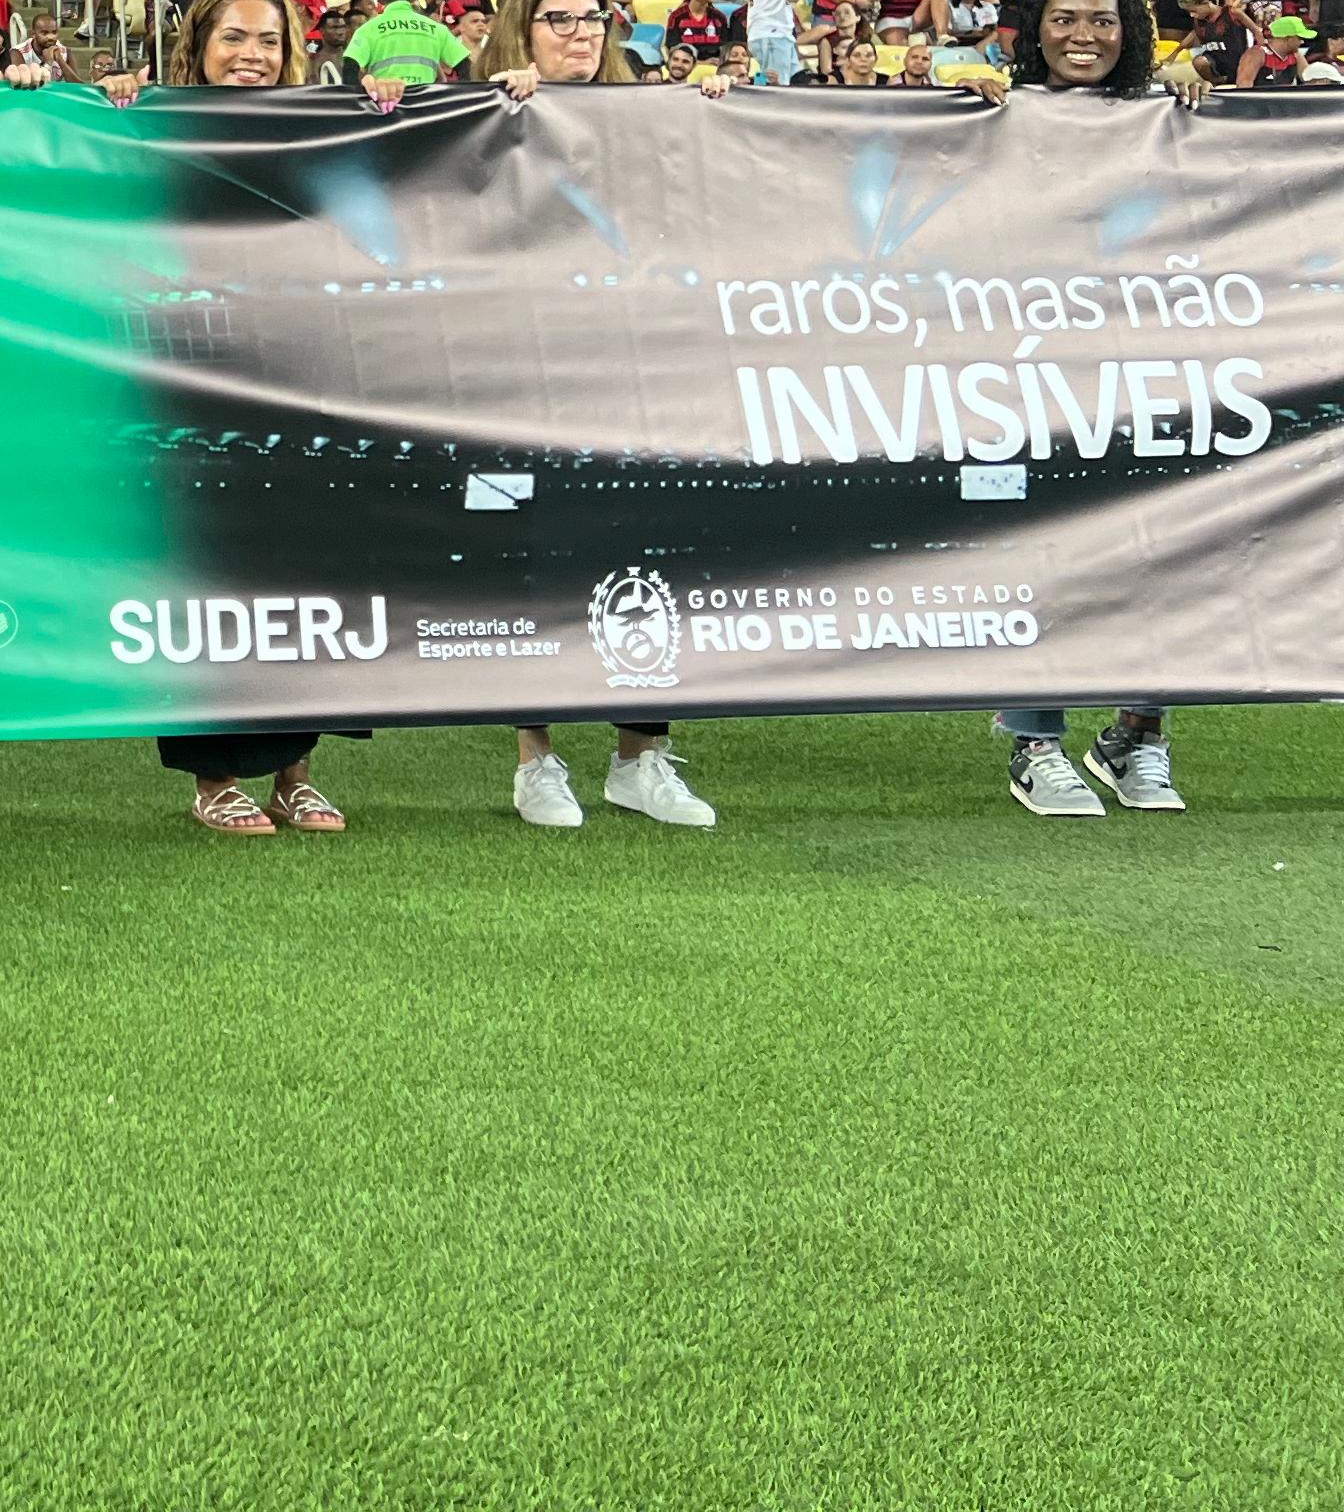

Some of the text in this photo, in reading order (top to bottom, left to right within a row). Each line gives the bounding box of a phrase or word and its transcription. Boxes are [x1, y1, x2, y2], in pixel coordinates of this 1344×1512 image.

[377, 18, 437, 35] SUNSET
[716, 254, 1266, 348] raros, mas não
[736, 335, 1274, 465] INVISÍVEIS
[687, 584, 1035, 610] GOVERNO DO ESTADO
[110, 594, 390, 665] SUDERJ
[416, 617, 536, 637] Secretaria de
[689, 609, 1039, 653] RIO DE JANEIRO
[417, 639, 561, 661] Esporte e Lazer
